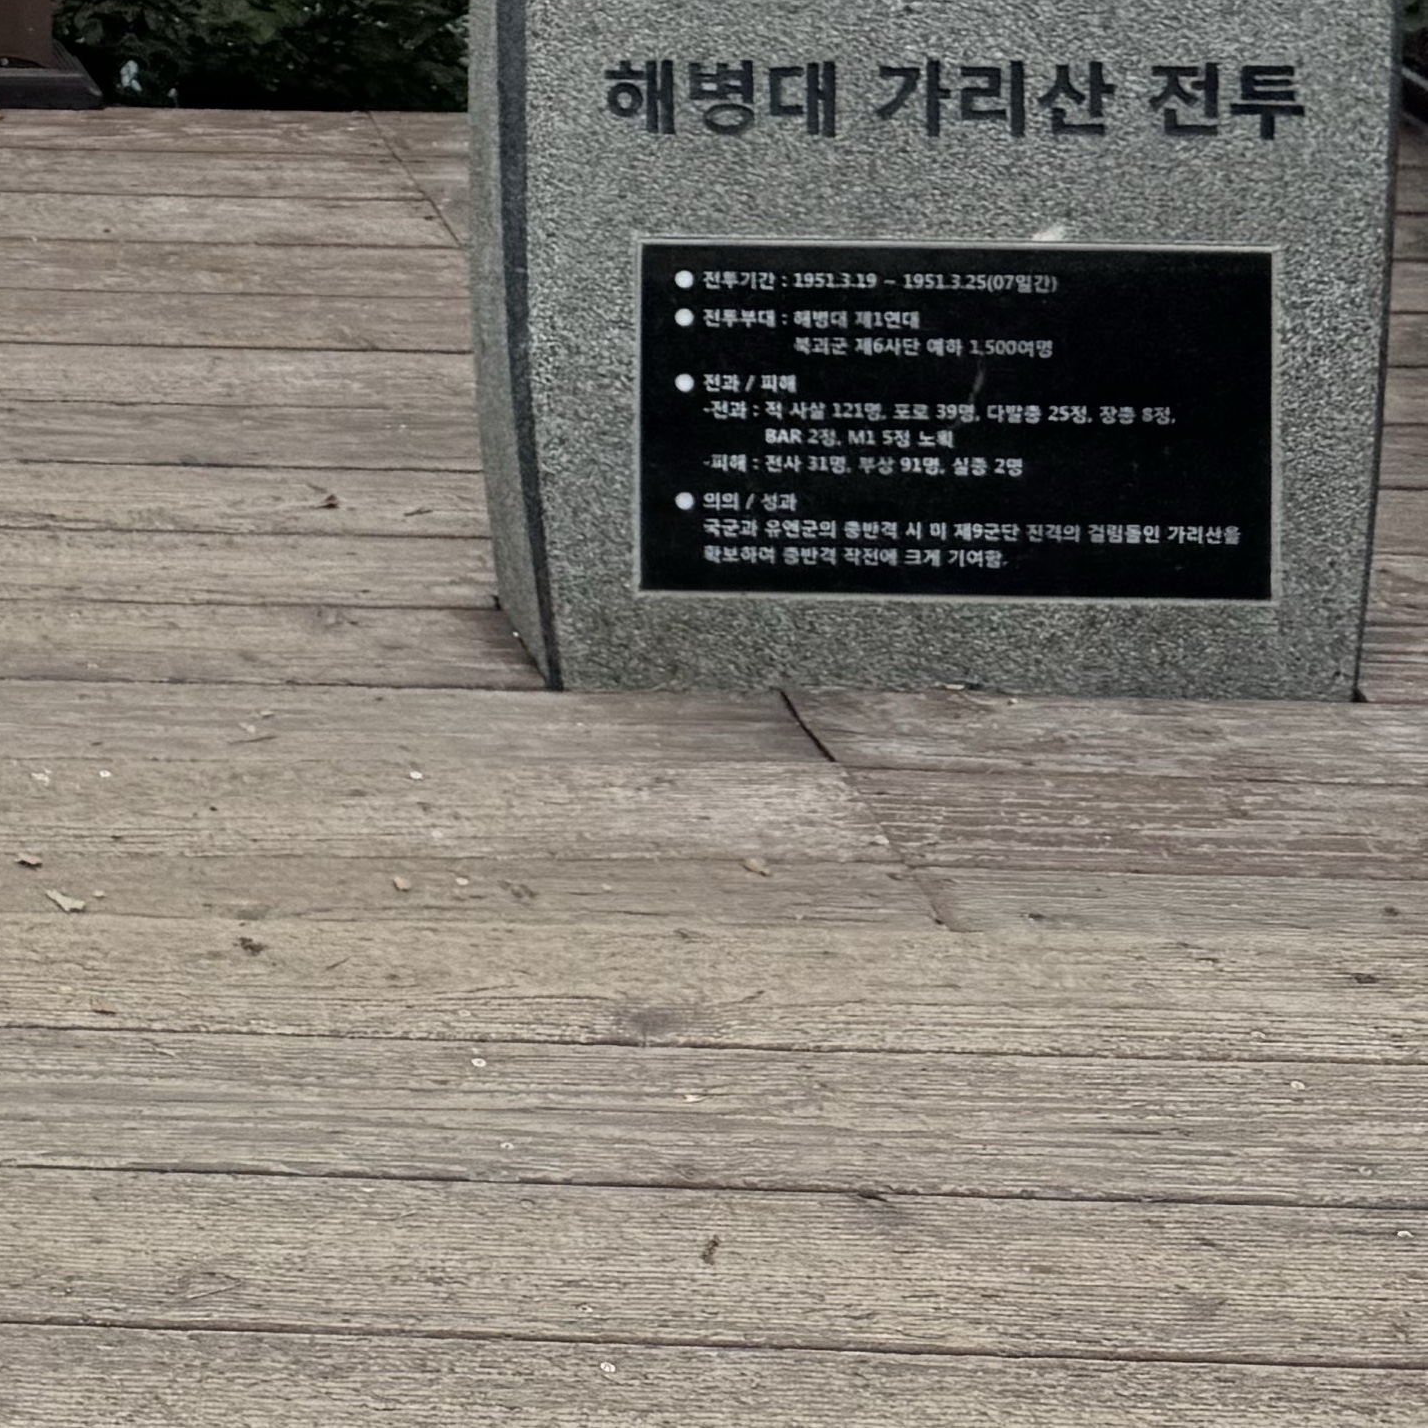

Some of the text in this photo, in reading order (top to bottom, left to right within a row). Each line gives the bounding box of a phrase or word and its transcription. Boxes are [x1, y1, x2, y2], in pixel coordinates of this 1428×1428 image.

[604, 59, 1307, 141] 해병대 가리산 전투
[703, 308, 776, 328] 전투부대
[793, 310, 848, 329] 해병대
[855, 310, 920, 330] 제1연대
[855, 337, 921, 356] 제6사단
[703, 373, 741, 393] 전과
[760, 374, 797, 393] 피해
[765, 400, 783, 420] 적
[789, 401, 826, 420] 사살
[893, 403, 930, 420] 포로
[764, 427, 803, 445] BAR
[848, 429, 876, 446] M1
[882, 429, 911, 448] 5정
[765, 454, 802, 473] 전사
[859, 456, 895, 475] 부상
[994, 458, 1023, 477] 2명
[703, 491, 740, 511] 의의
[761, 492, 798, 512] 성과
[703, 518, 759, 538] 국군과
[764, 519, 837, 539] 유엔군의
[905, 521, 922, 541] 시
[929, 521, 947, 541] 미
[953, 522, 1021, 542] 제9군단
[1026, 524, 1081, 543] 진격의
[1167, 525, 1241, 545] 가리산을
[704, 544, 776, 564] 확보하여
[843, 547, 898, 566] 작전에
[904, 548, 941, 567] 크게
